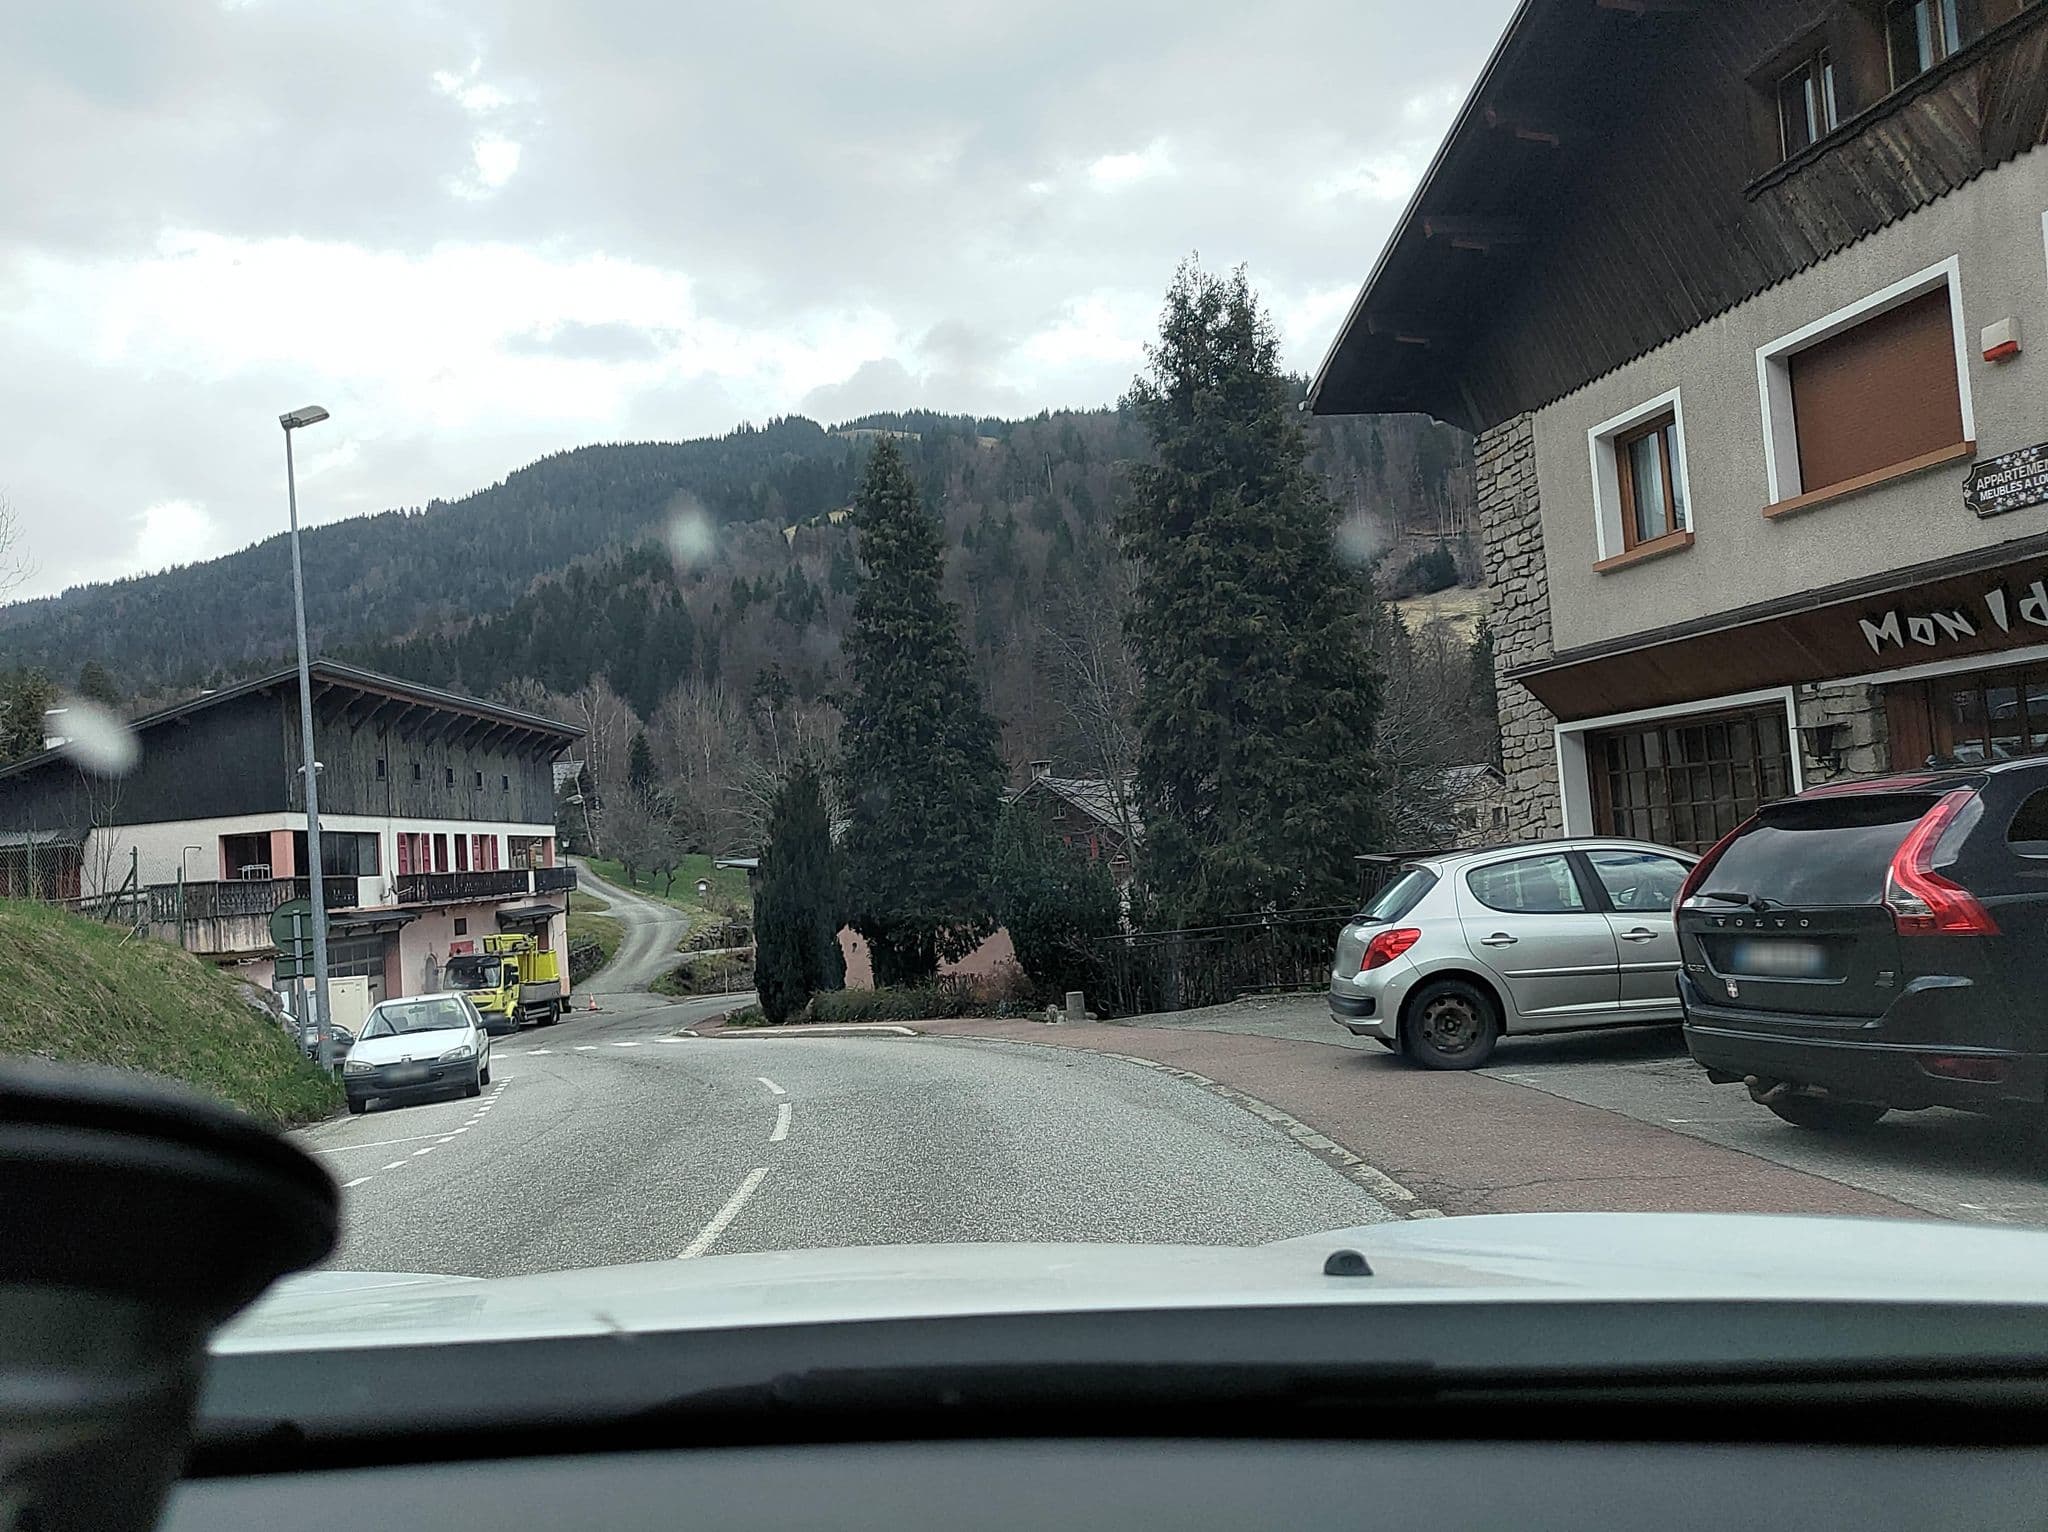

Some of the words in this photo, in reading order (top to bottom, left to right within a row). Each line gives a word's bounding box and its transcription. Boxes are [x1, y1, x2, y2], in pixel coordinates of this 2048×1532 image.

[1980, 480, 2023, 501] MEUBLES
[2024, 478, 2033, 489] A
[1717, 918, 1809, 927] VOLVO
